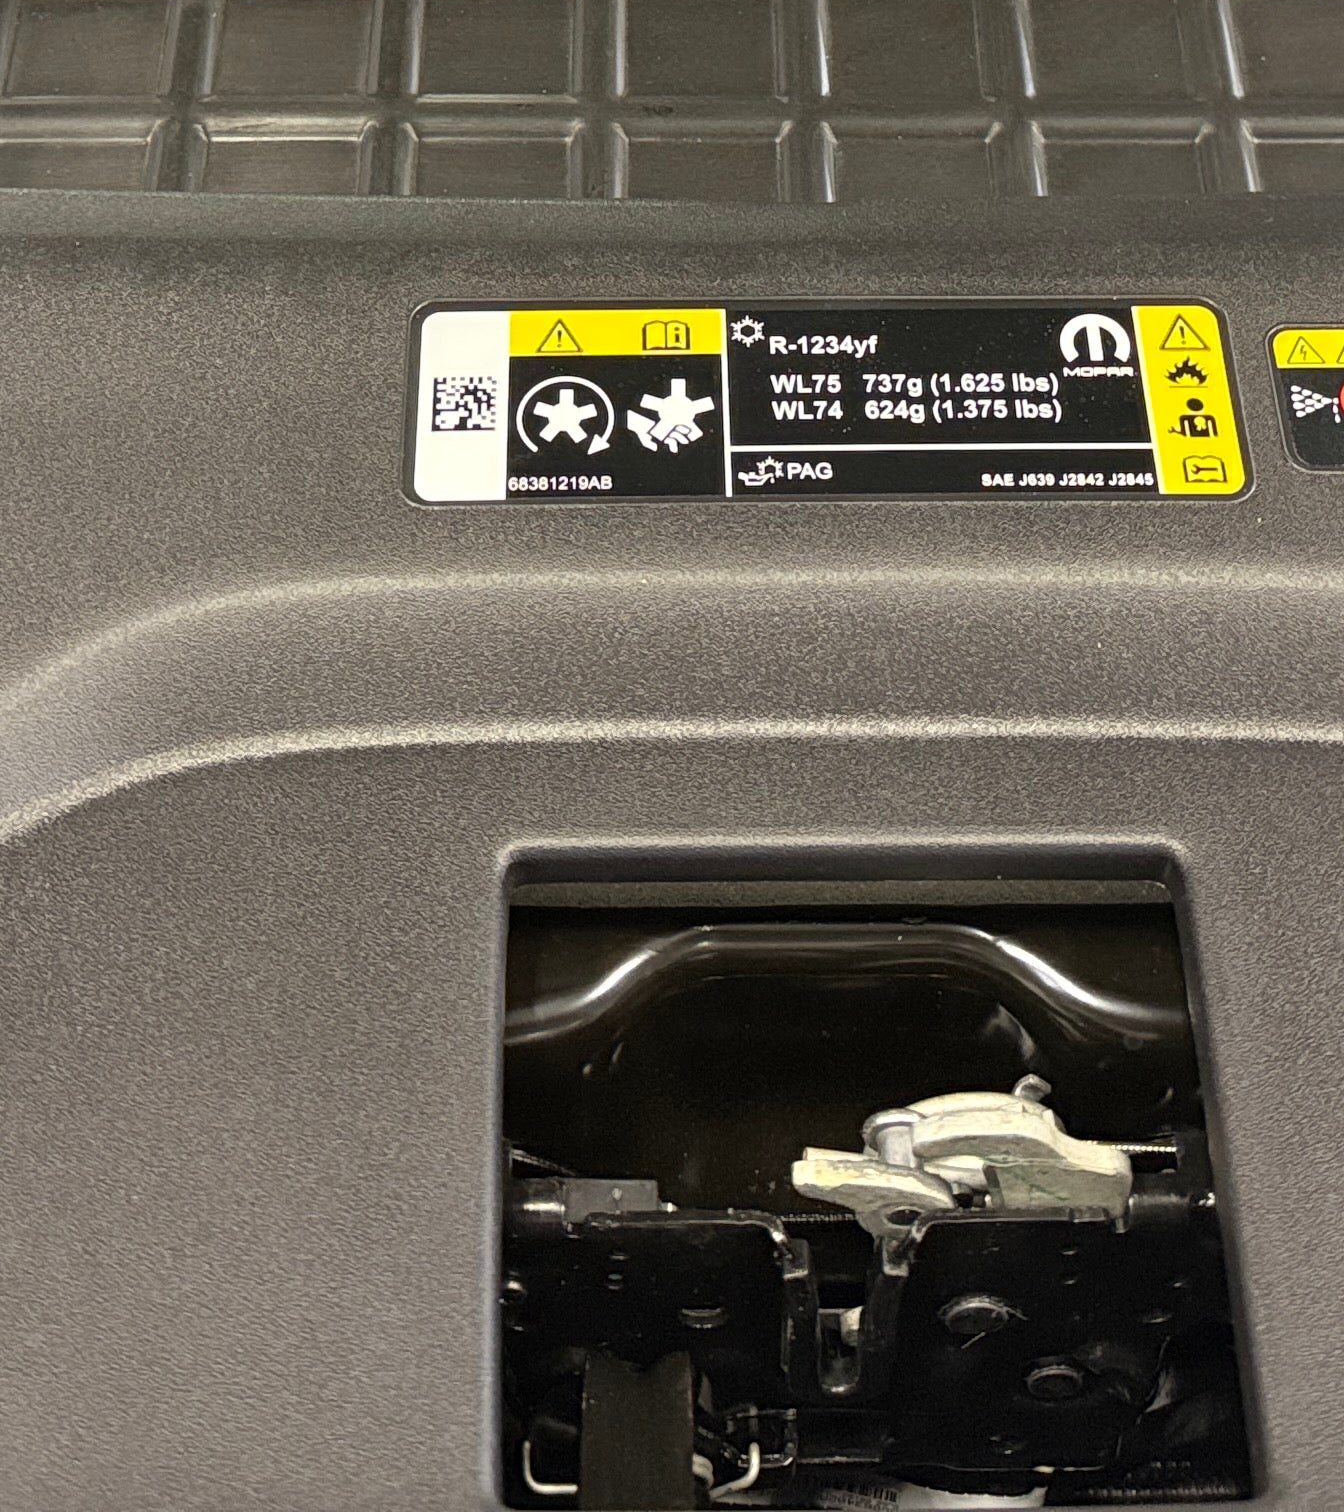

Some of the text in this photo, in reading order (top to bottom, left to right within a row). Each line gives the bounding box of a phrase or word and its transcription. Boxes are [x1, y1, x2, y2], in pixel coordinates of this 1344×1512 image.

[769, 335, 878, 358] R-1234yf
[1063, 366, 1134, 378] MOPAR
[769, 372, 1059, 397] WL75 737g (1.625 lbs)
[771, 398, 1062, 423] WL74 624g (1.375 lbs)
[786, 461, 834, 480] PAG
[981, 472, 1155, 487] SAE J639 J2842 J2845
[507, 474, 613, 492] 68381219AB
